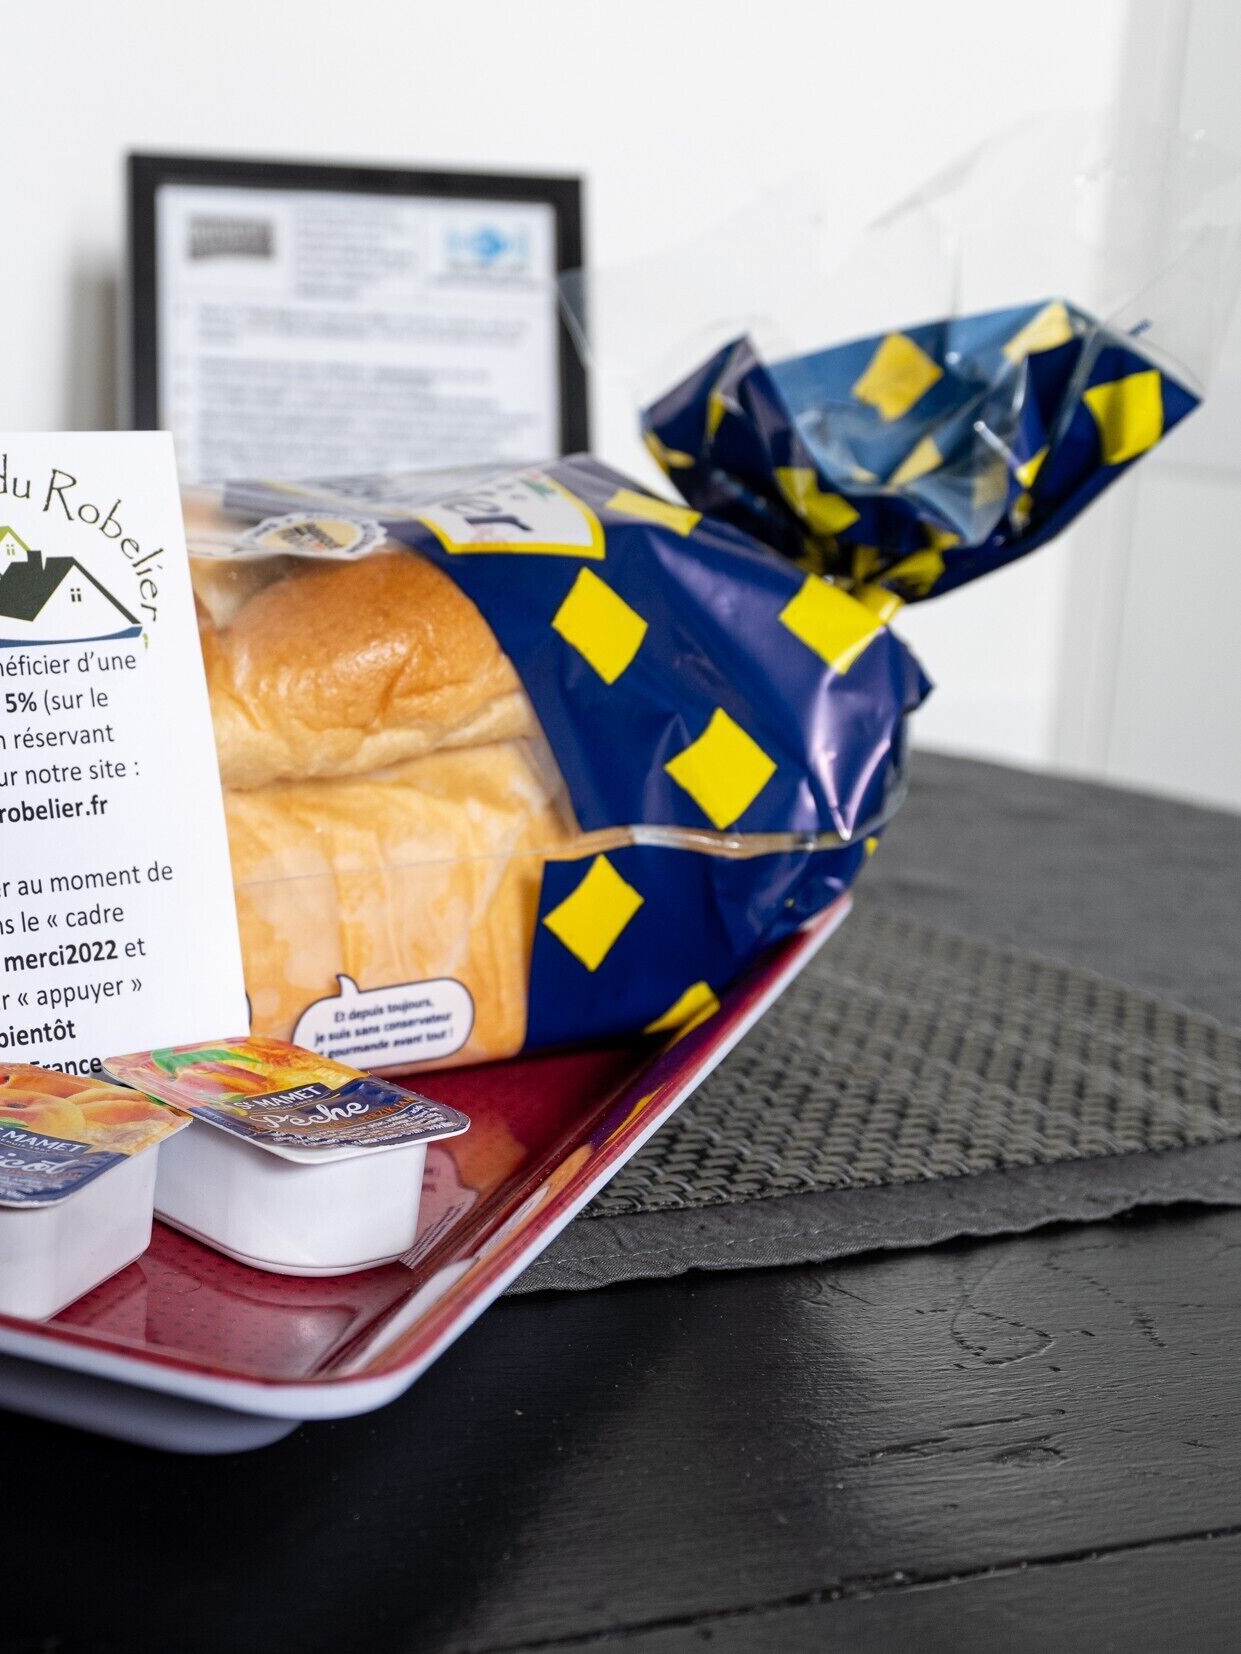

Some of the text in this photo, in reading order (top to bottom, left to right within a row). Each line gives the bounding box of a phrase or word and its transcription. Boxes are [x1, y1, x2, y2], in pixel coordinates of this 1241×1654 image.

[42, 468, 164, 622] Robelier
[77, 651, 136, 673] d'une
[5, 691, 38, 714] 5%
[44, 689, 84, 716] (sur
[90, 687, 108, 708] le
[13, 724, 115, 749] réservant
[25, 764, 82, 785] notre
[89, 759, 126, 780] site
[17, 878, 43, 896] au
[50, 866, 141, 893] moment
[147, 860, 173, 883] de
[20, 911, 40, 933] le
[65, 903, 124, 928] cadre
[3, 939, 119, 973] merci2022
[124, 938, 146, 958] et
[36, 979, 124, 1010] appuyer
[328, 1027, 352, 1040] suis
[355, 1023, 381, 1038] sans
[384, 1011, 453, 1033] conservateur
[348, 1004, 385, 1024] depuis
[393, 1032, 424, 1048] avant
[426, 1028, 448, 1042] tout
[30, 1056, 103, 1076] ance
[253, 1085, 322, 1108] MAMET
[2, 1130, 87, 1153] MAMET
